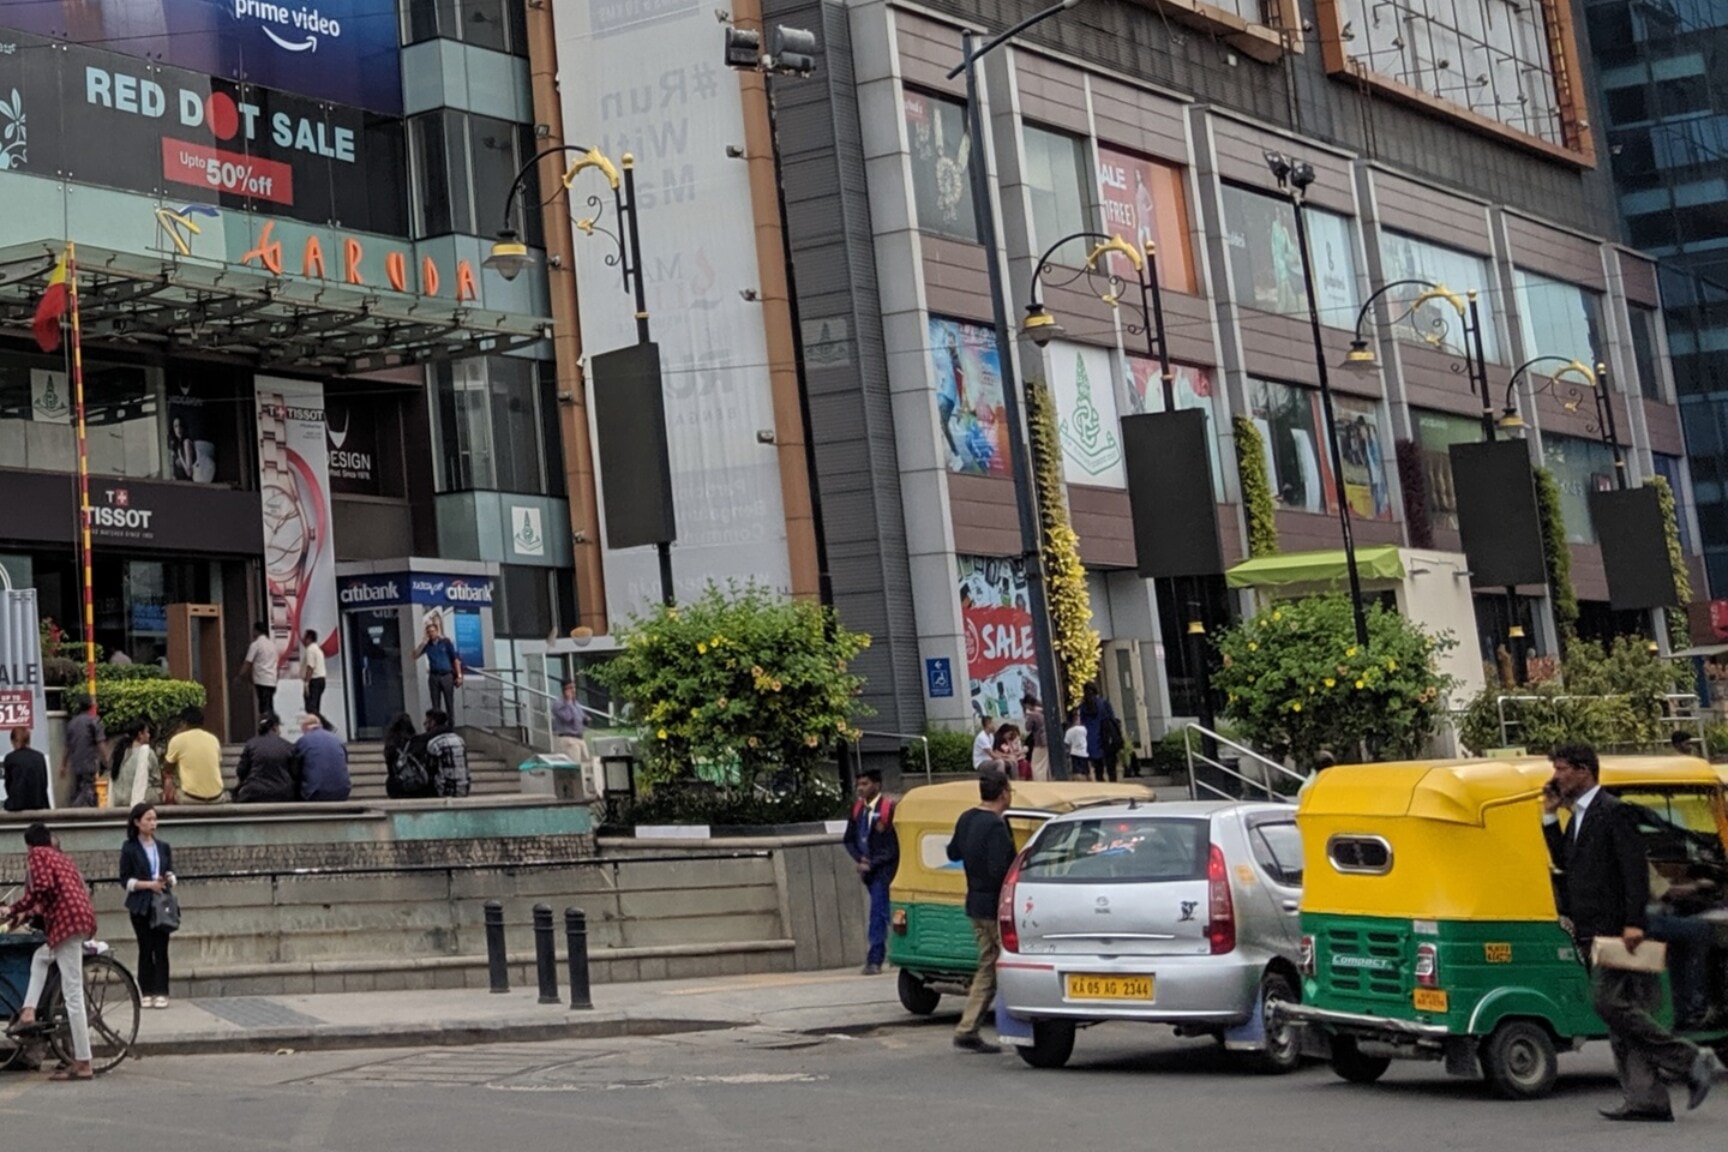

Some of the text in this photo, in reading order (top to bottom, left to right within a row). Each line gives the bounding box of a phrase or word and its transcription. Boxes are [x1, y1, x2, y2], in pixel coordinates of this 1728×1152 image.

[292, 9, 341, 38] video
[85, 65, 166, 118] RED
[272, 112, 355, 164] SALE
[180, 151, 206, 169] Upto
[241, 220, 477, 302] GARUDA
[288, 409, 324, 421] TISSOT
[81, 507, 152, 529] TISSOT
[341, 581, 399, 603] citibank
[982, 624, 1035, 660] SALE
[1072, 977, 1086, 993] KA
[1087, 978, 1100, 994] 05
[1122, 980, 1149, 997] 2344
